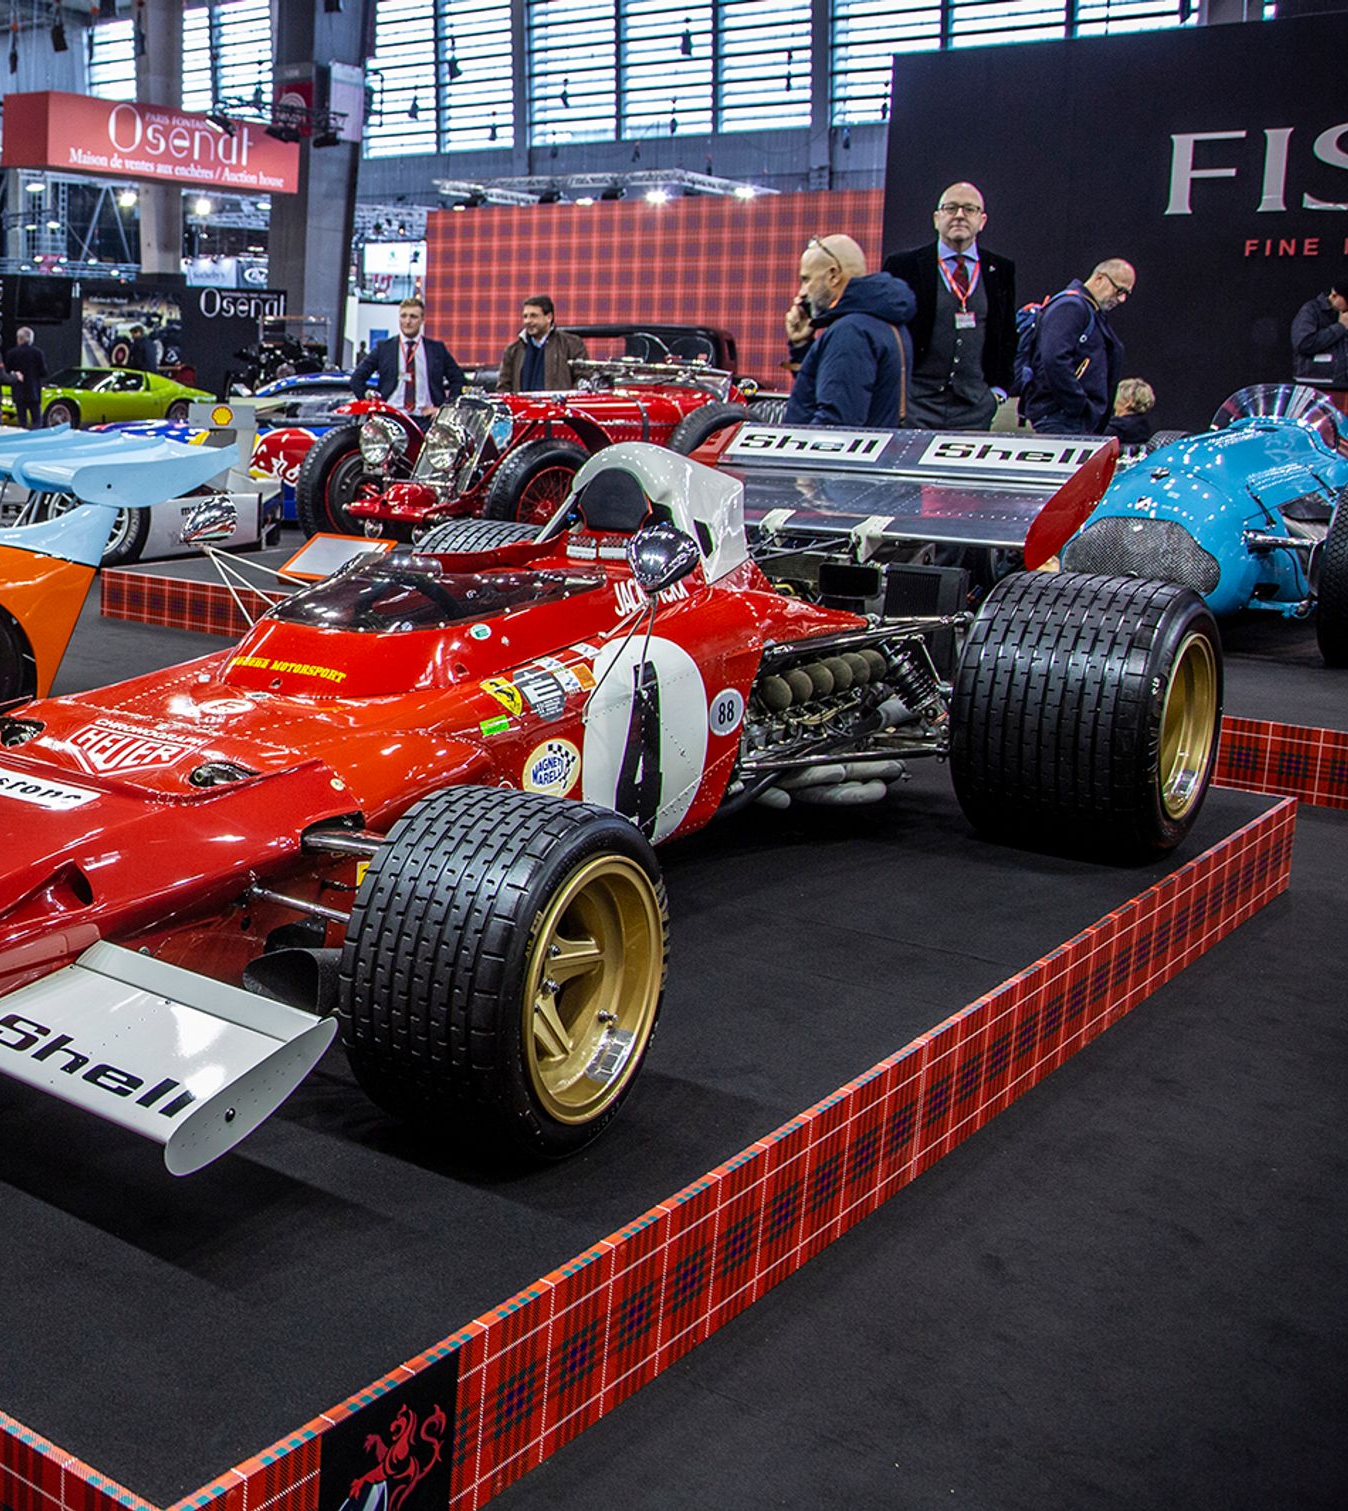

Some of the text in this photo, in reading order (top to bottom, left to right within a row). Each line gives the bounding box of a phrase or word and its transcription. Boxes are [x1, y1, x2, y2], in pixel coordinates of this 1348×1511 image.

[69, 147, 109, 167] Maison
[110, 153, 122, 168] de
[124, 159, 155, 172] ventes
[155, 163, 174, 175] aux
[221, 167, 258, 185] Auction
[258, 170, 285, 188] house
[1244, 237, 1320, 256] FINE
[739, 434, 879, 454] Shell
[934, 443, 1095, 465] Shell
[269, 660, 347, 683] MOTORSPORT
[718, 700, 735, 725] 88
[95, 719, 215, 746] CHRONOGRAPH
[75, 728, 181, 770] HEUER
